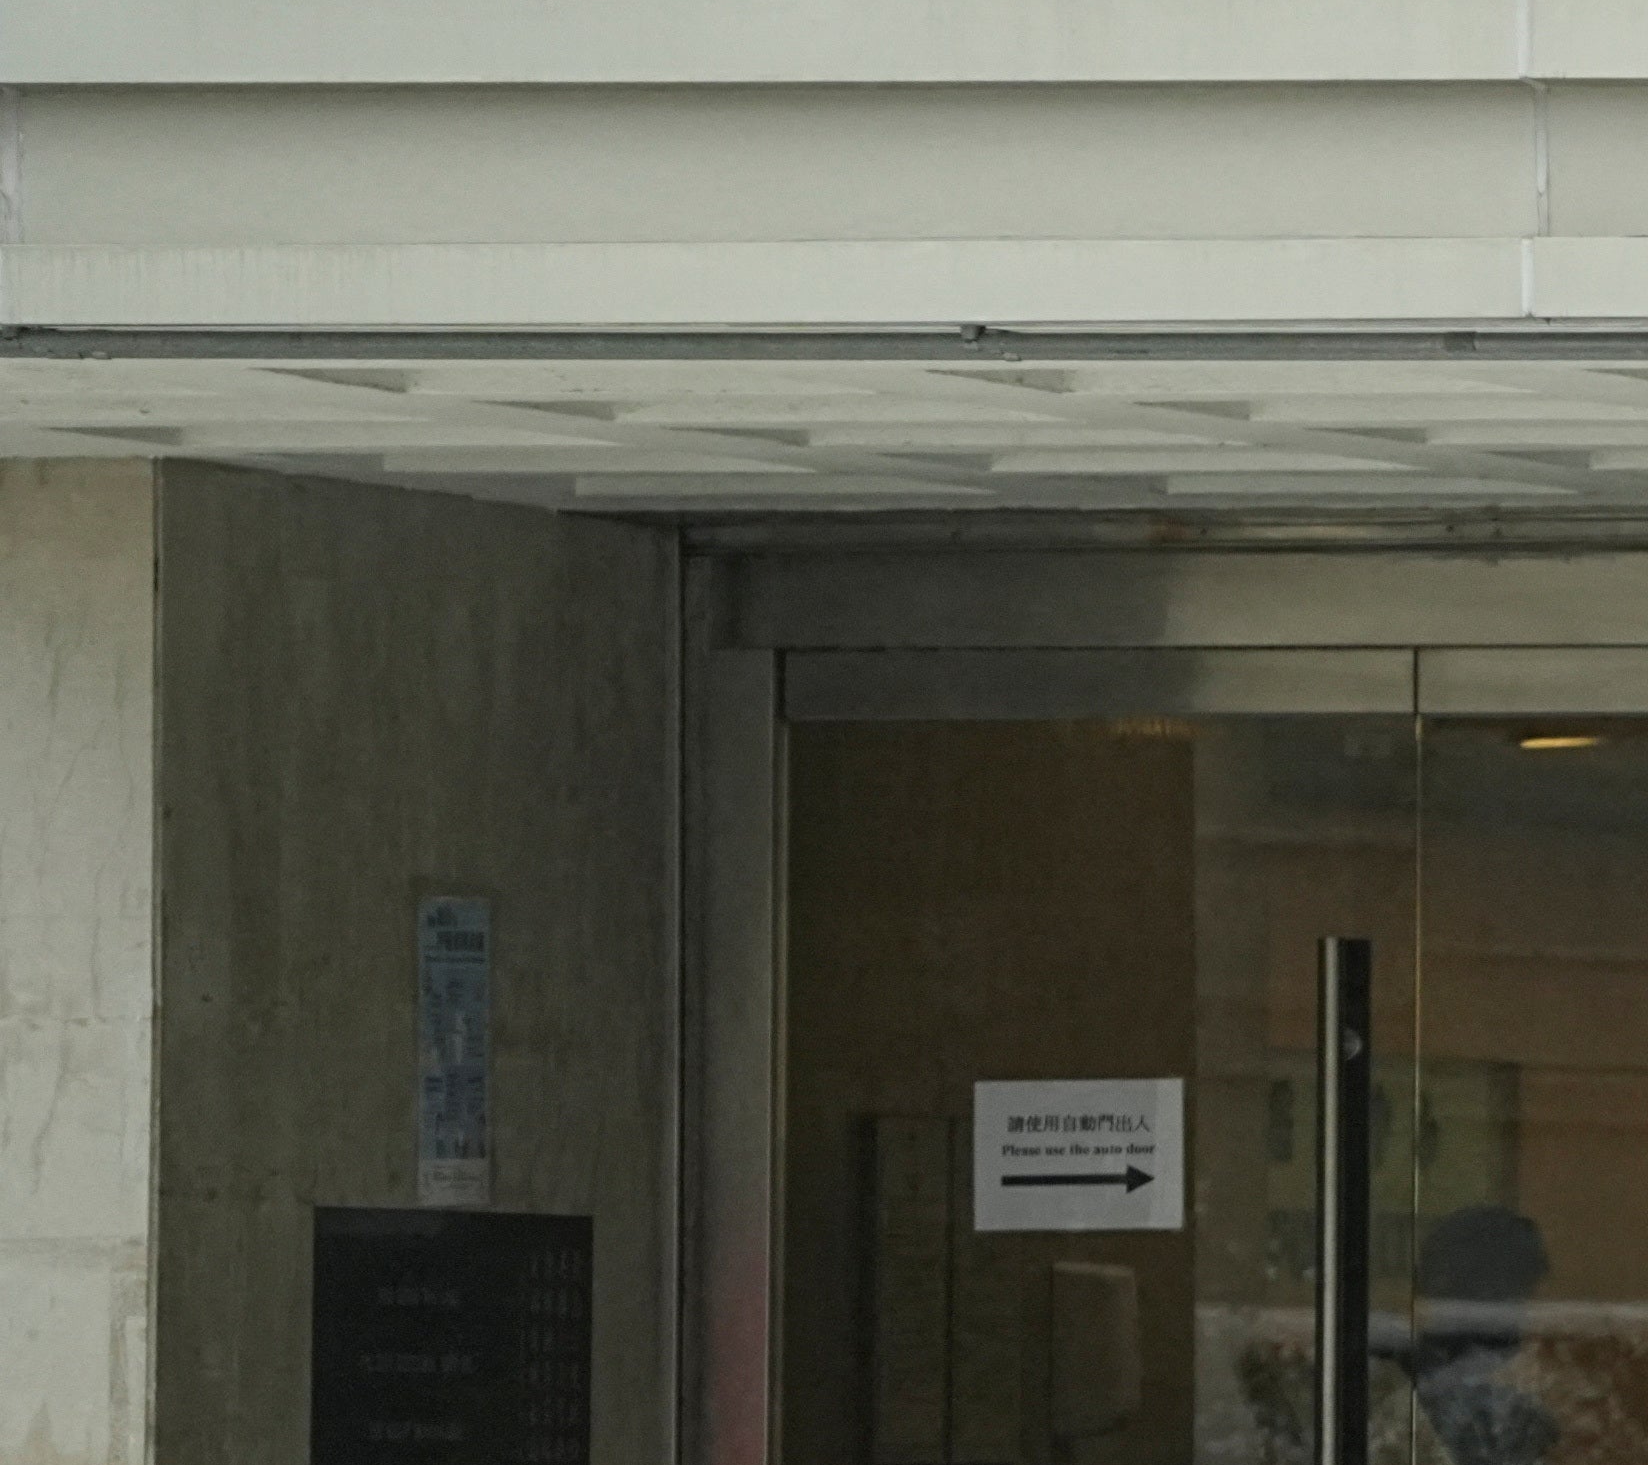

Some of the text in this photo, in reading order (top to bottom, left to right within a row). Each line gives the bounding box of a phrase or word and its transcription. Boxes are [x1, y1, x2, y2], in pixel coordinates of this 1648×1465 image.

[1001, 1142, 1156, 1156] Please use the auto door
